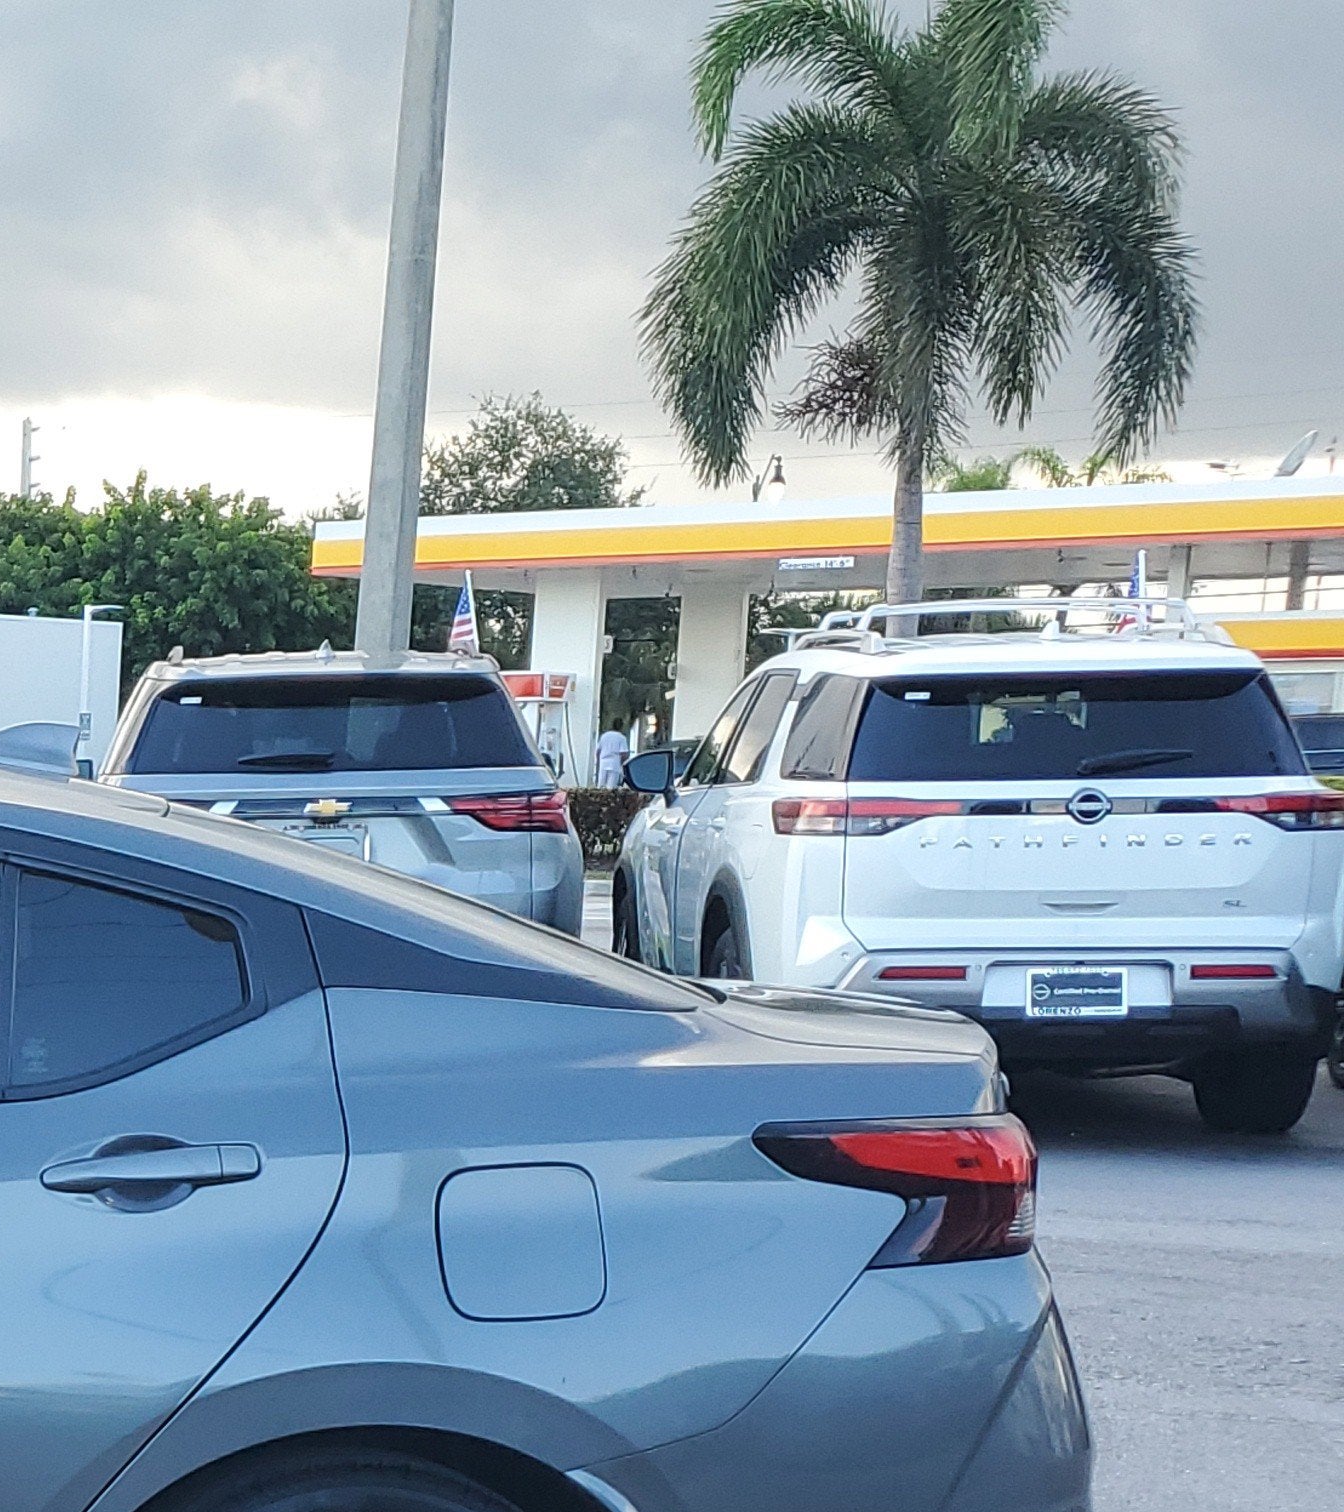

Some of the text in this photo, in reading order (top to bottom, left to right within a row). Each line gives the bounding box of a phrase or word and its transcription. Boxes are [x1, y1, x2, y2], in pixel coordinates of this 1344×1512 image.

[918, 832, 1254, 850] PATHFINDER
[1222, 899, 1249, 908] SL
[1032, 1006, 1082, 1016] LORENZO
